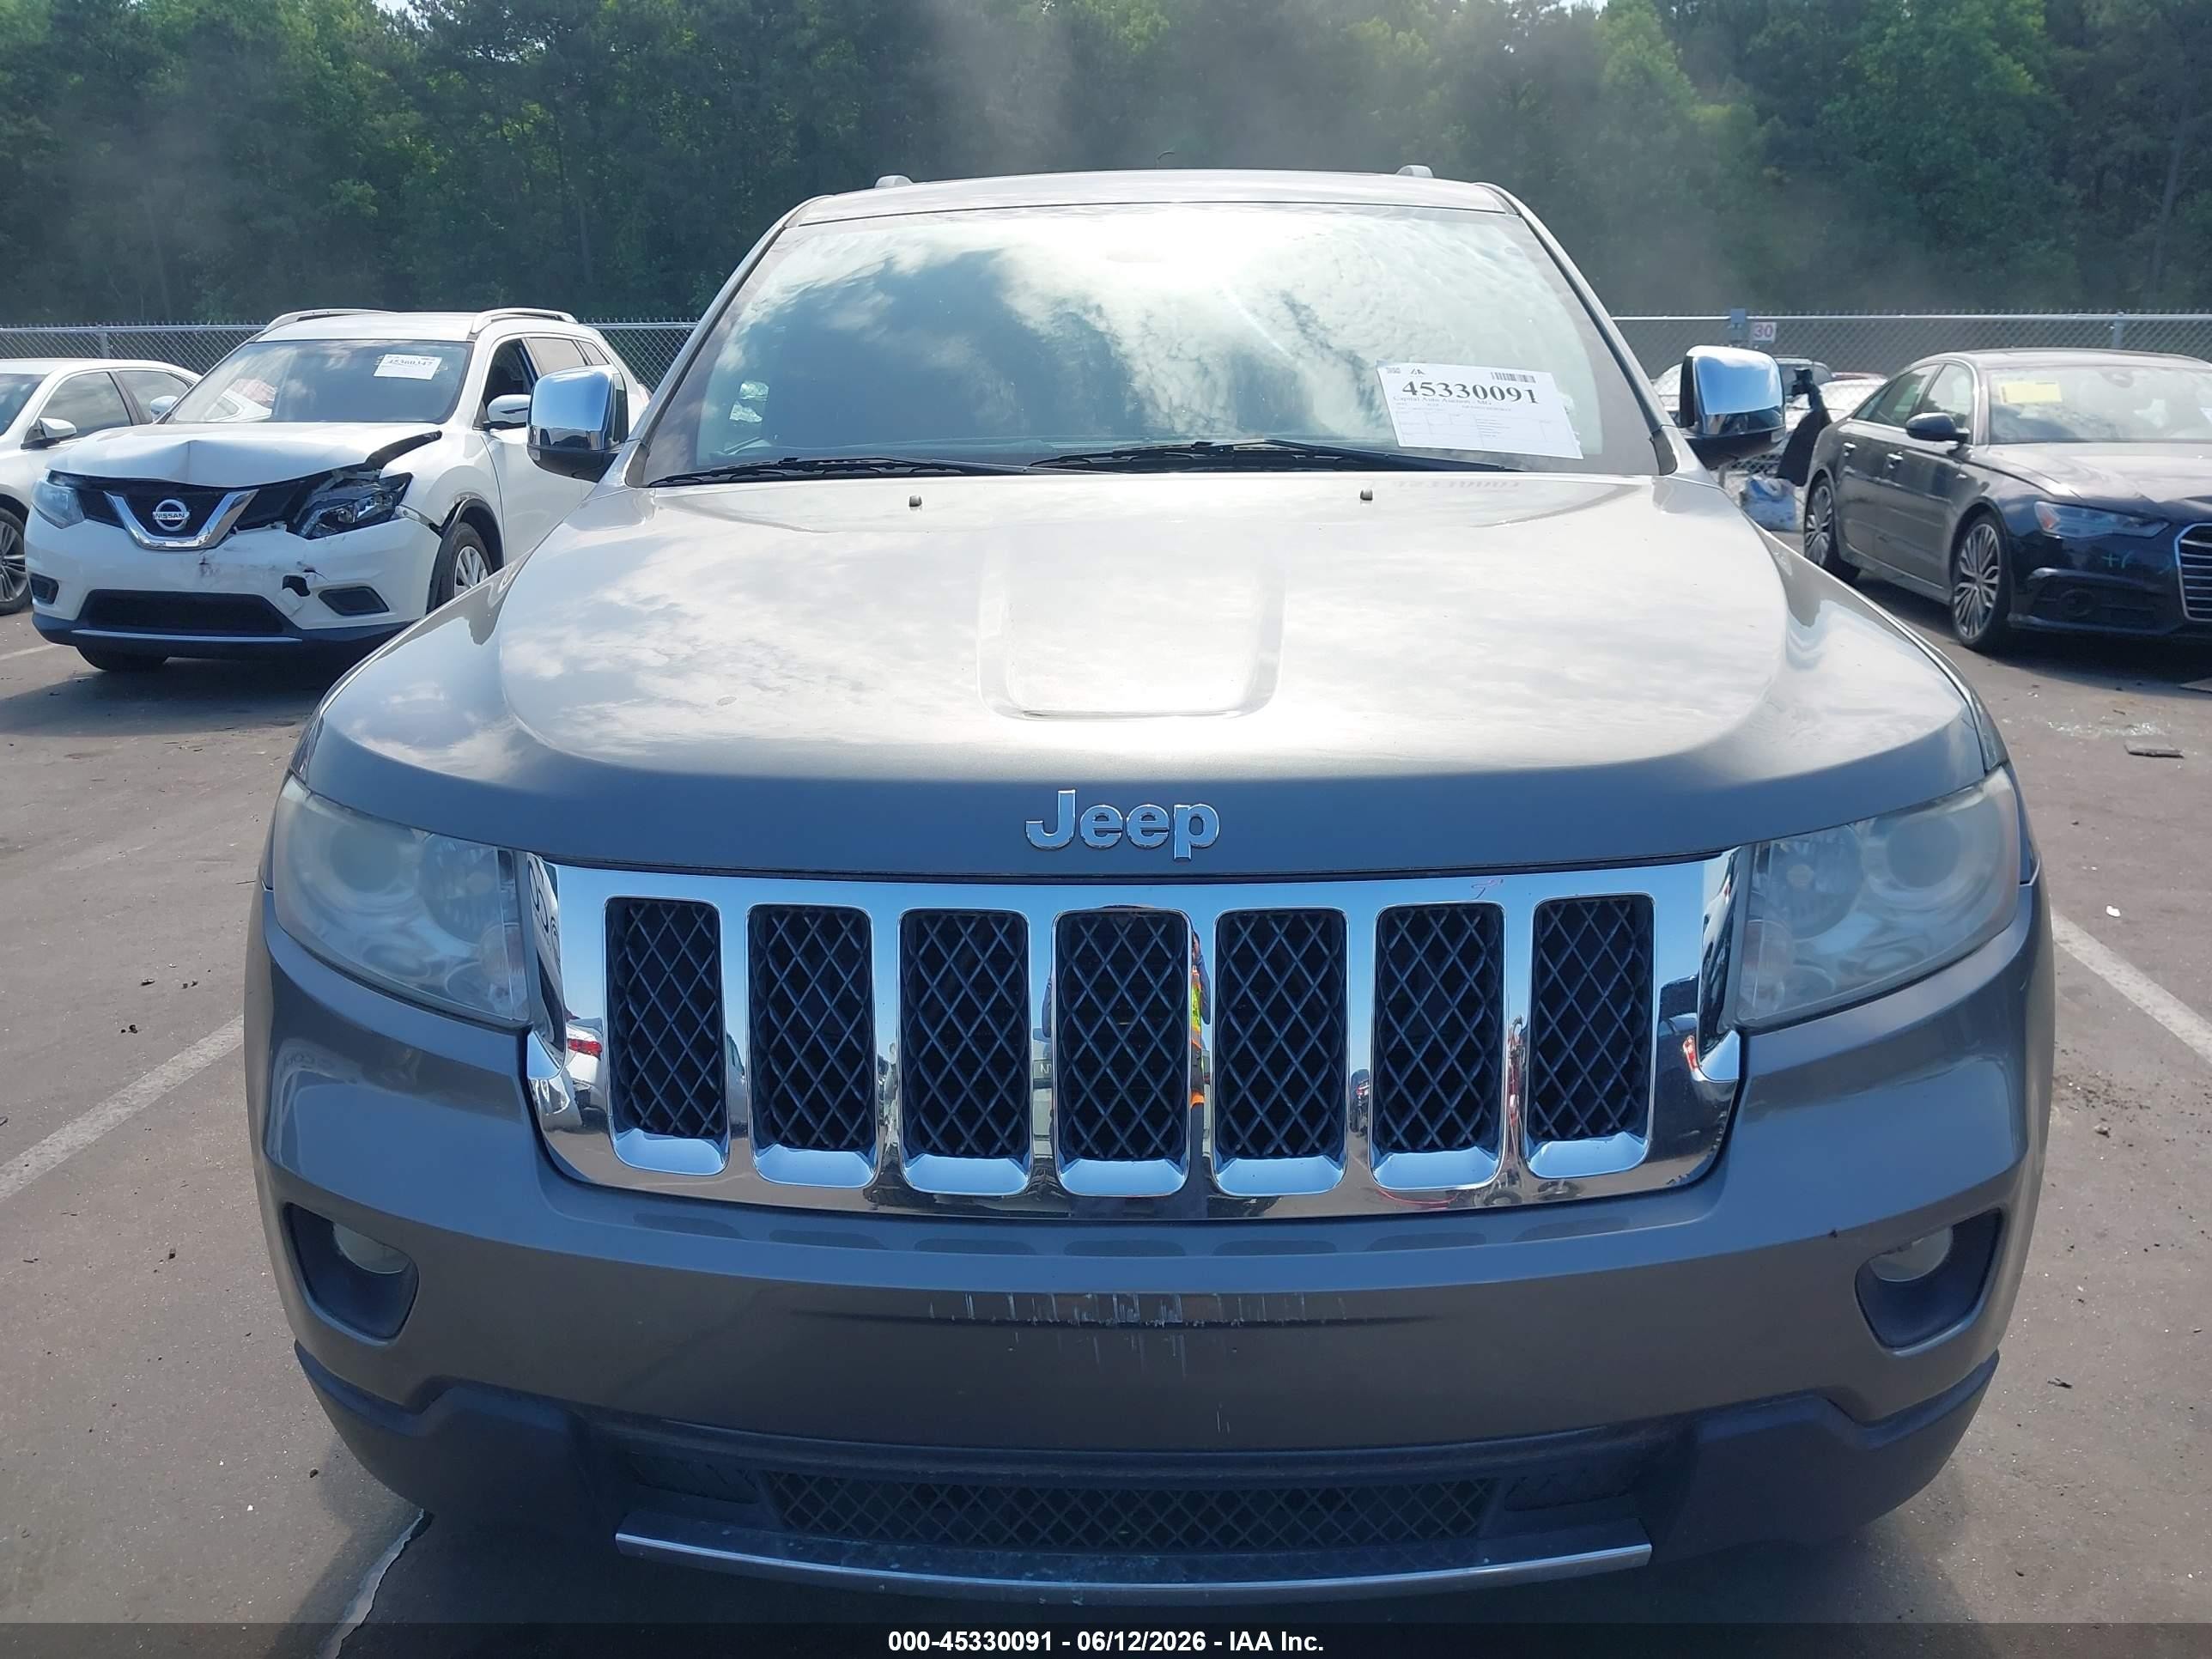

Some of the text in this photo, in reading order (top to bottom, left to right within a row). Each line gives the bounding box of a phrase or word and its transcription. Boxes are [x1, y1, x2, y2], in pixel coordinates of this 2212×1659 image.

[1753, 324, 1773, 338] 30
[1402, 381, 1539, 404] 45330091
[1025, 788, 1220, 860] Jeep
